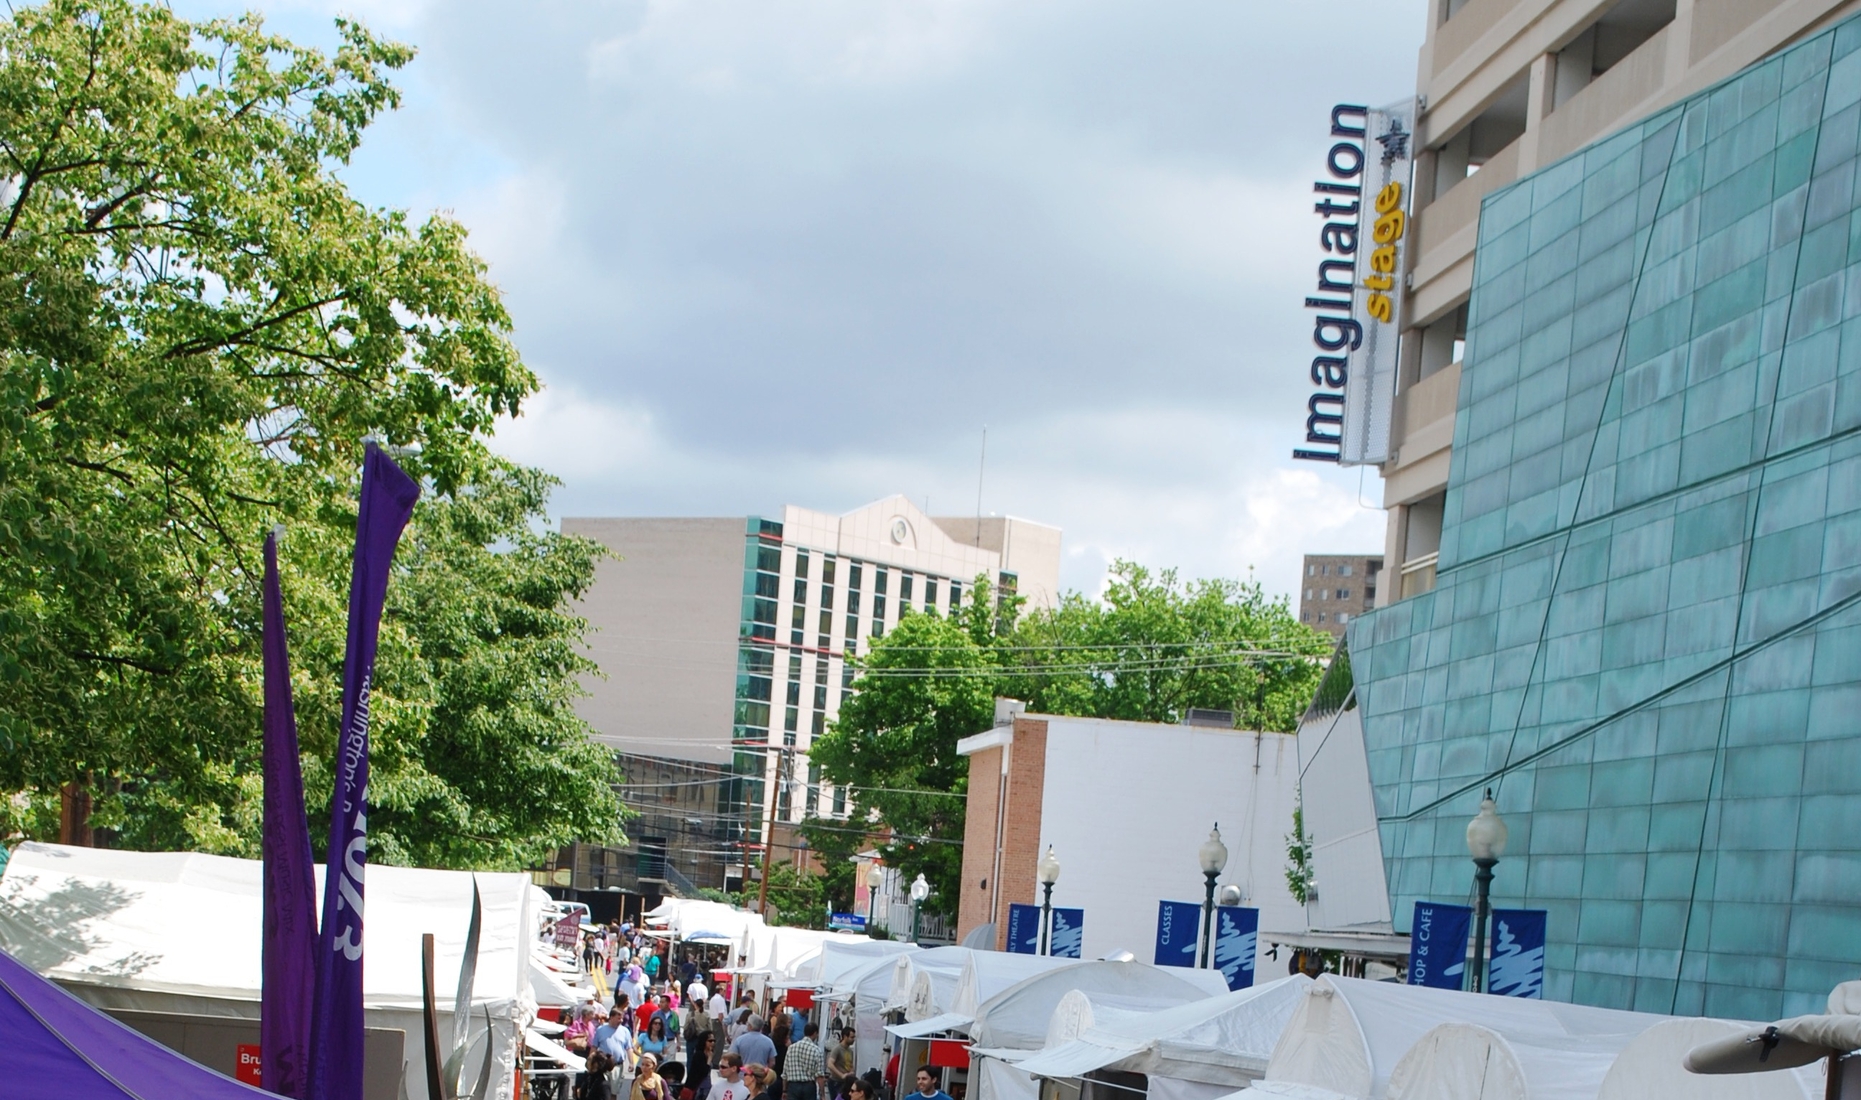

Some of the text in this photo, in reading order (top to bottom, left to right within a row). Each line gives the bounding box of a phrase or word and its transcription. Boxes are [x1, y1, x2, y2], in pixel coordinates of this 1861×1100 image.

[1363, 180, 1404, 323] stage
[1292, 102, 1368, 464] Imagination
[1011, 909, 1020, 940] THEATRE
[1161, 905, 1173, 945] CLASSES
[1419, 908, 1433, 940] CAFE
[1418, 945, 1429, 956] &
